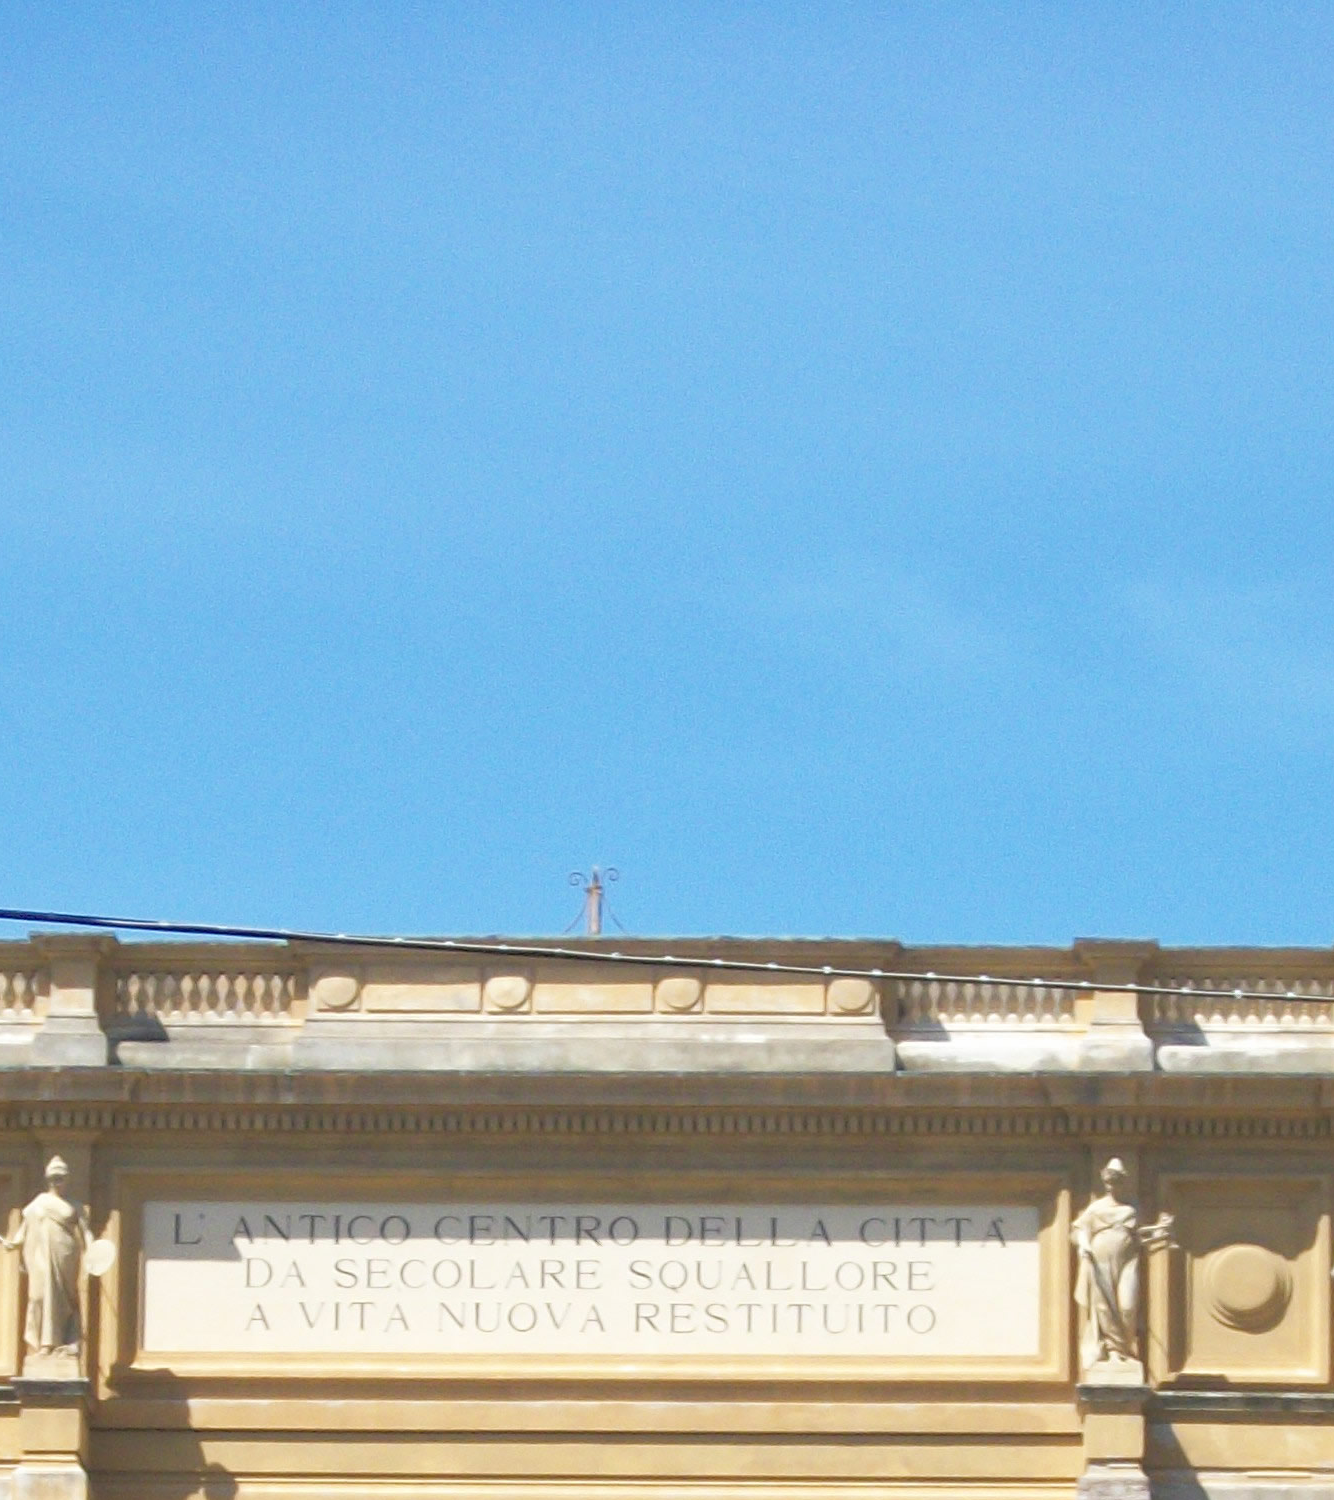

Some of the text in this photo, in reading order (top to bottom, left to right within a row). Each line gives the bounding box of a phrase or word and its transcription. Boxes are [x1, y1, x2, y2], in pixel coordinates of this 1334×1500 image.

[228, 1214, 412, 1246] ANTICO
[433, 1215, 640, 1247] CENTRO
[664, 1215, 834, 1247] DELLA
[244, 1257, 936, 1293] DA SECOLARE SQUALLORE
[244, 1302, 937, 1334] A VITA NUOVA RESTITUITO
